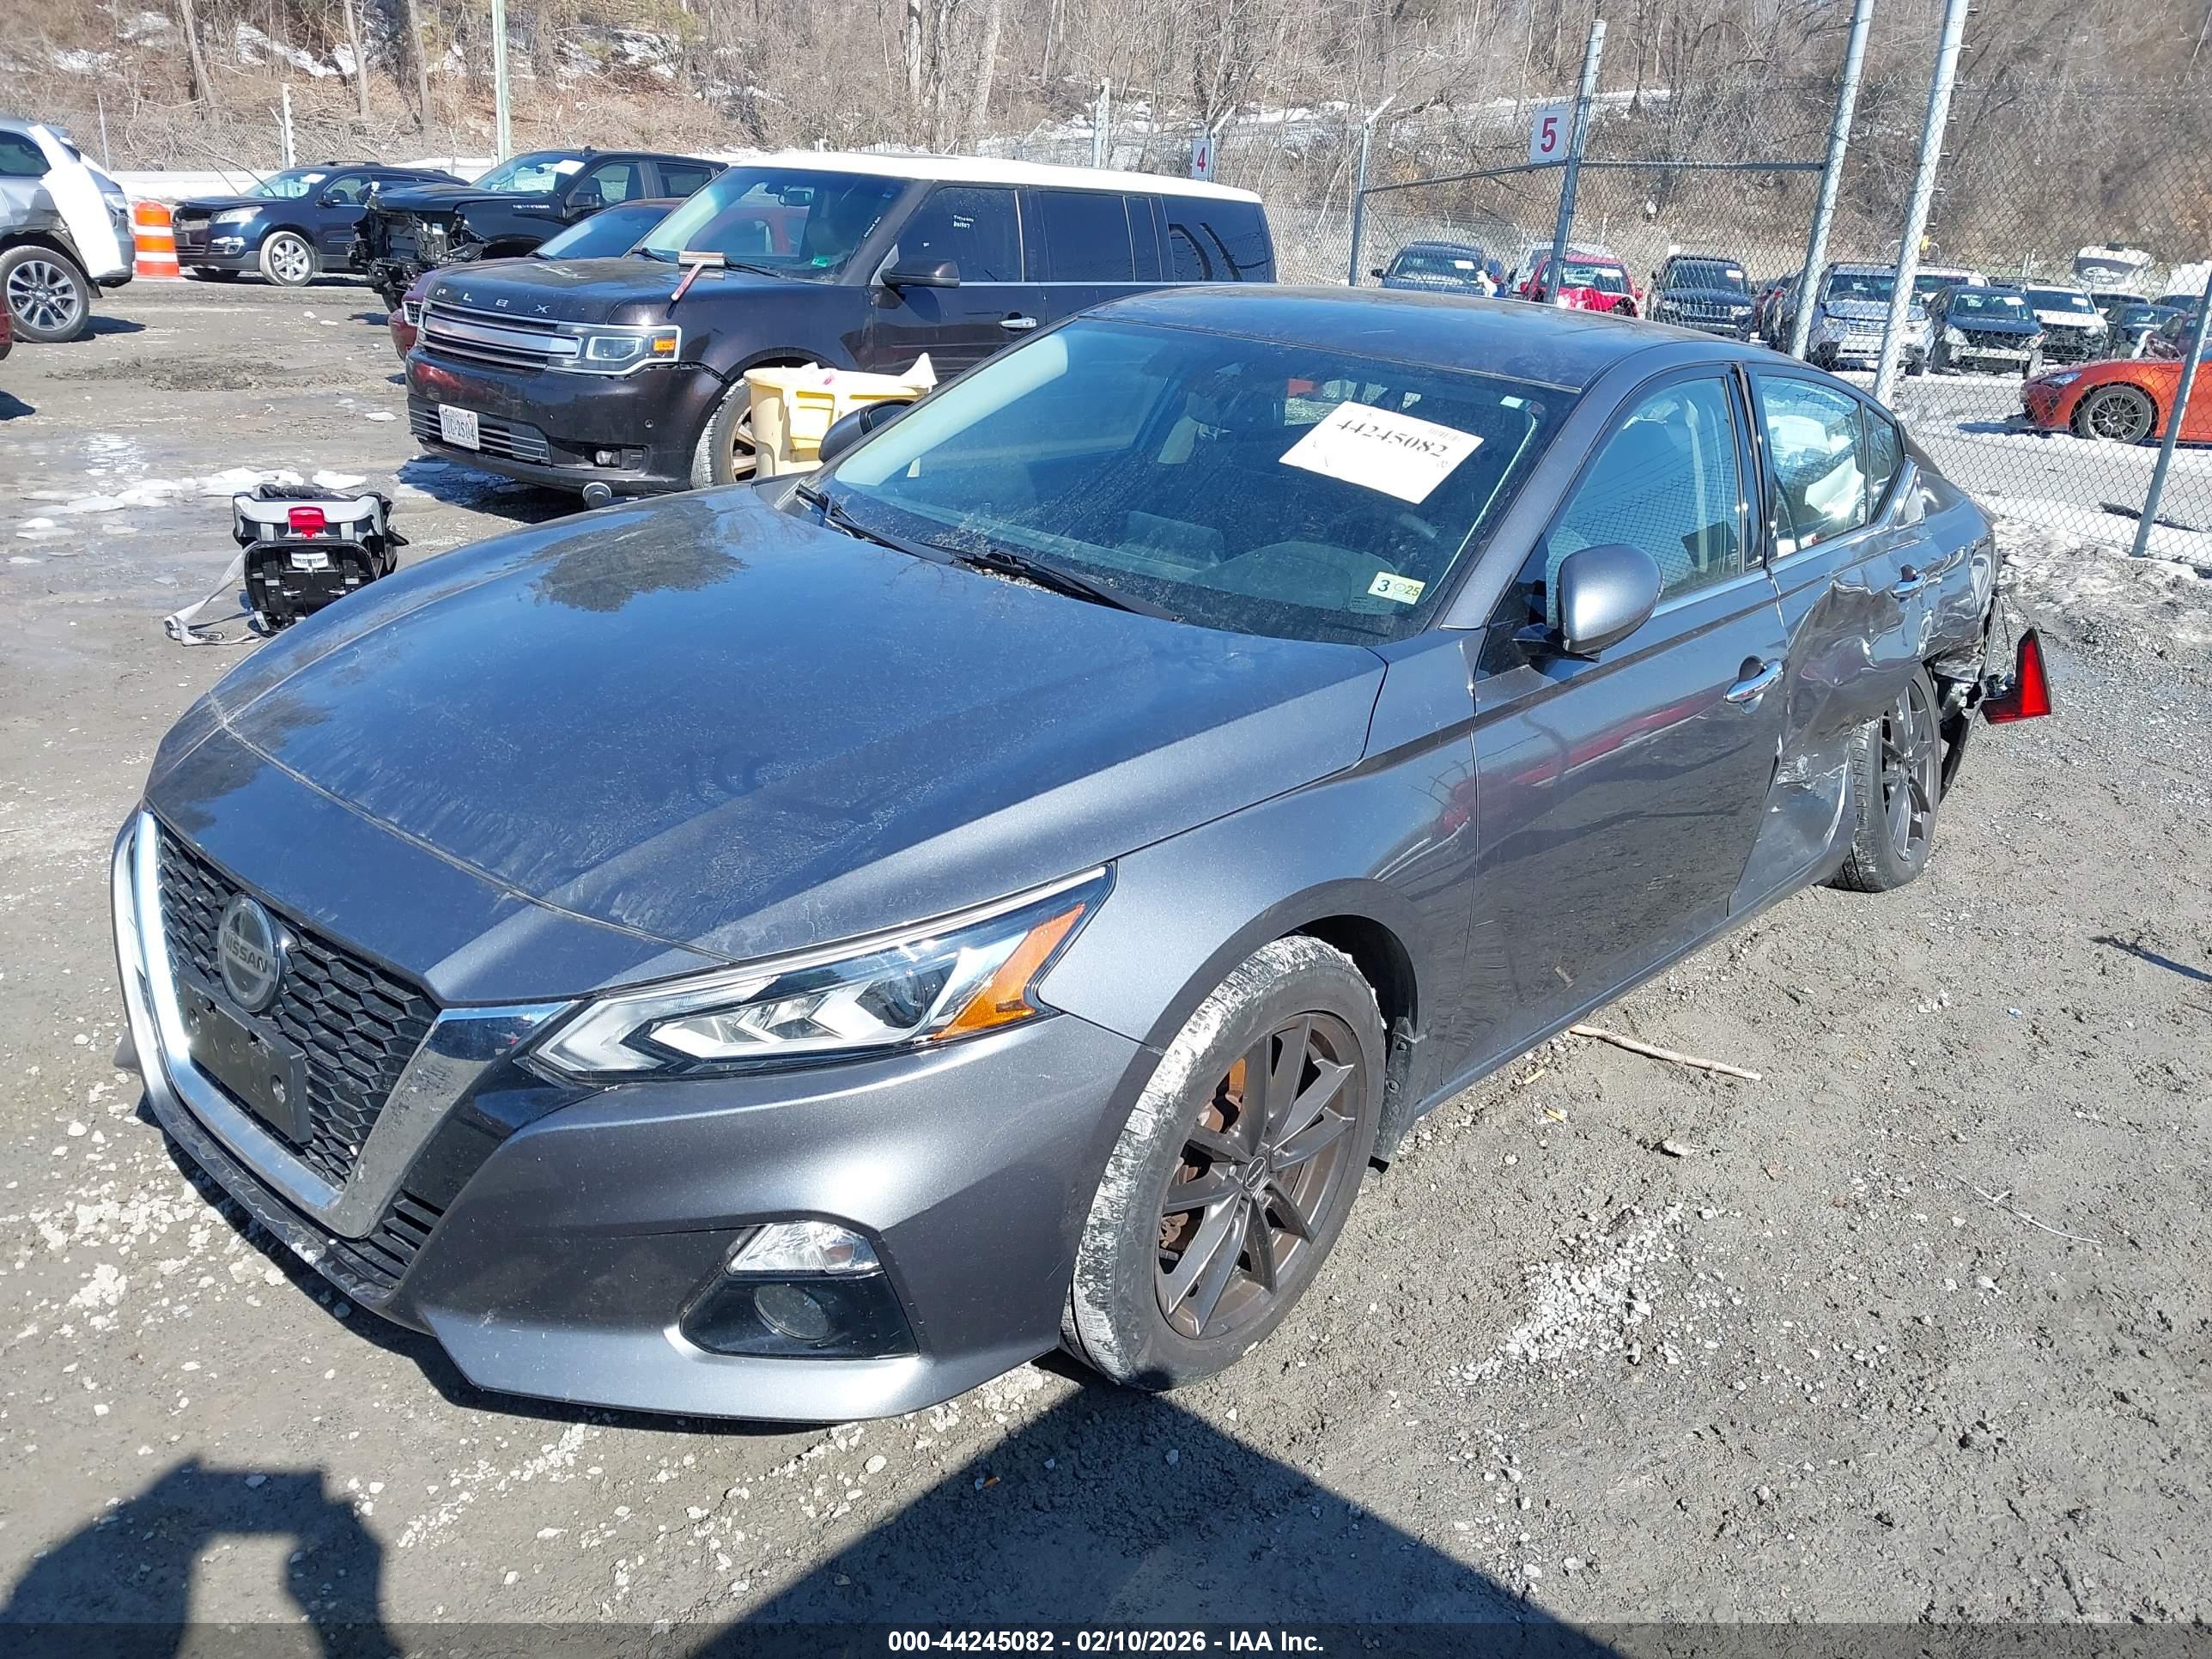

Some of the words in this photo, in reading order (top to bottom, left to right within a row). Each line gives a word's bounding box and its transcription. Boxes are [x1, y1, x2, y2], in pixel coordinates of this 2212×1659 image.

[1540, 117, 1558, 153] 5
[1196, 147, 1206, 173] 4
[1336, 418, 1449, 458] 44245082
[1377, 579, 1391, 592] 3
[1405, 585, 1421, 597] 25
[223, 930, 269, 974] NISSAN
